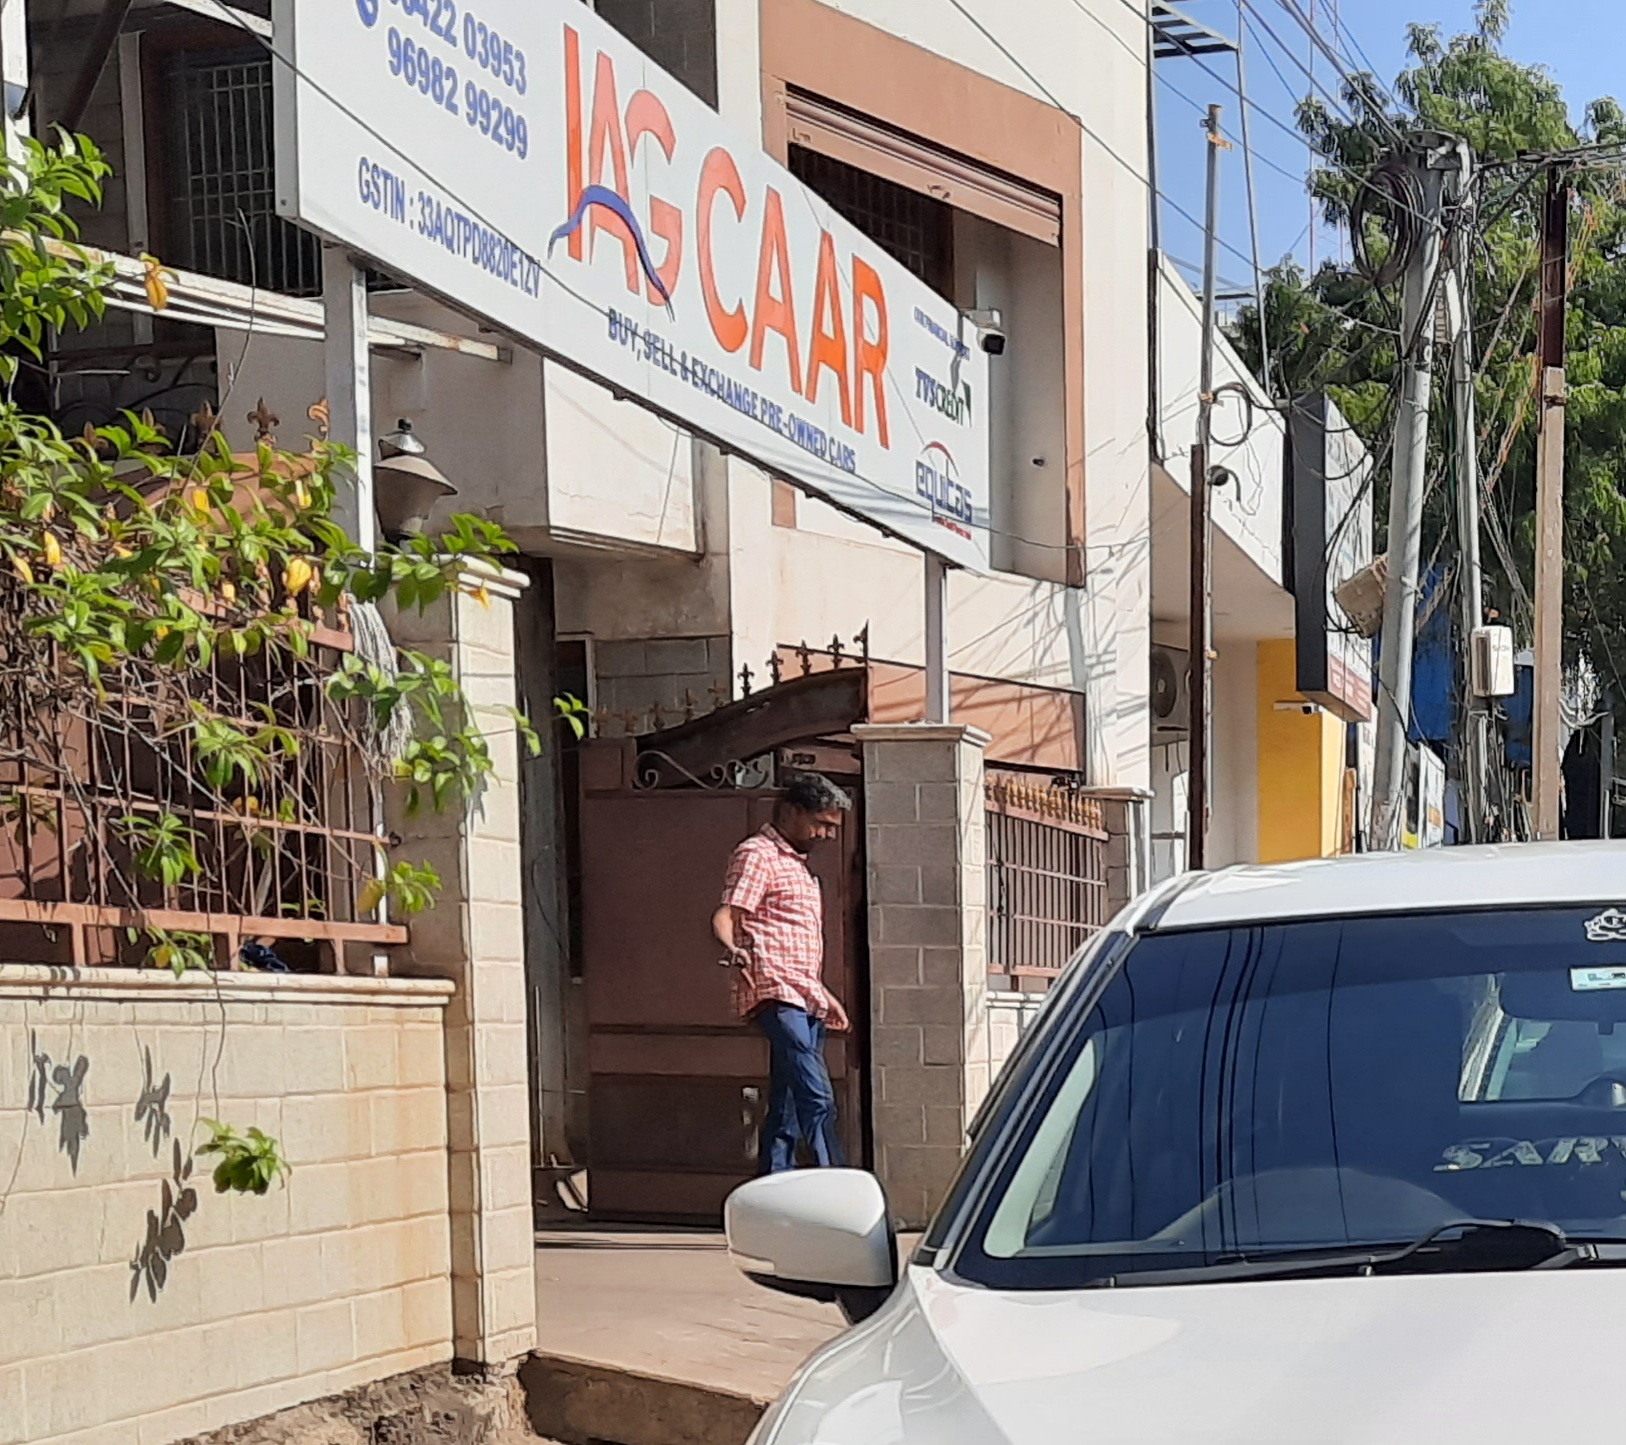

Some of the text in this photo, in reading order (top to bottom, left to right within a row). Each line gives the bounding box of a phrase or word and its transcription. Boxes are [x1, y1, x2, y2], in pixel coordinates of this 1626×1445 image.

[388, 27, 528, 159] 96982 99299
[463, 12, 527, 95] 03953
[359, 156, 405, 224] GSTIN
[696, 146, 890, 450] CAAR
[691, 356, 758, 421] EXCHANGE
[761, 397, 827, 457] PRE-OWNED
[829, 435, 856, 474] CARS
